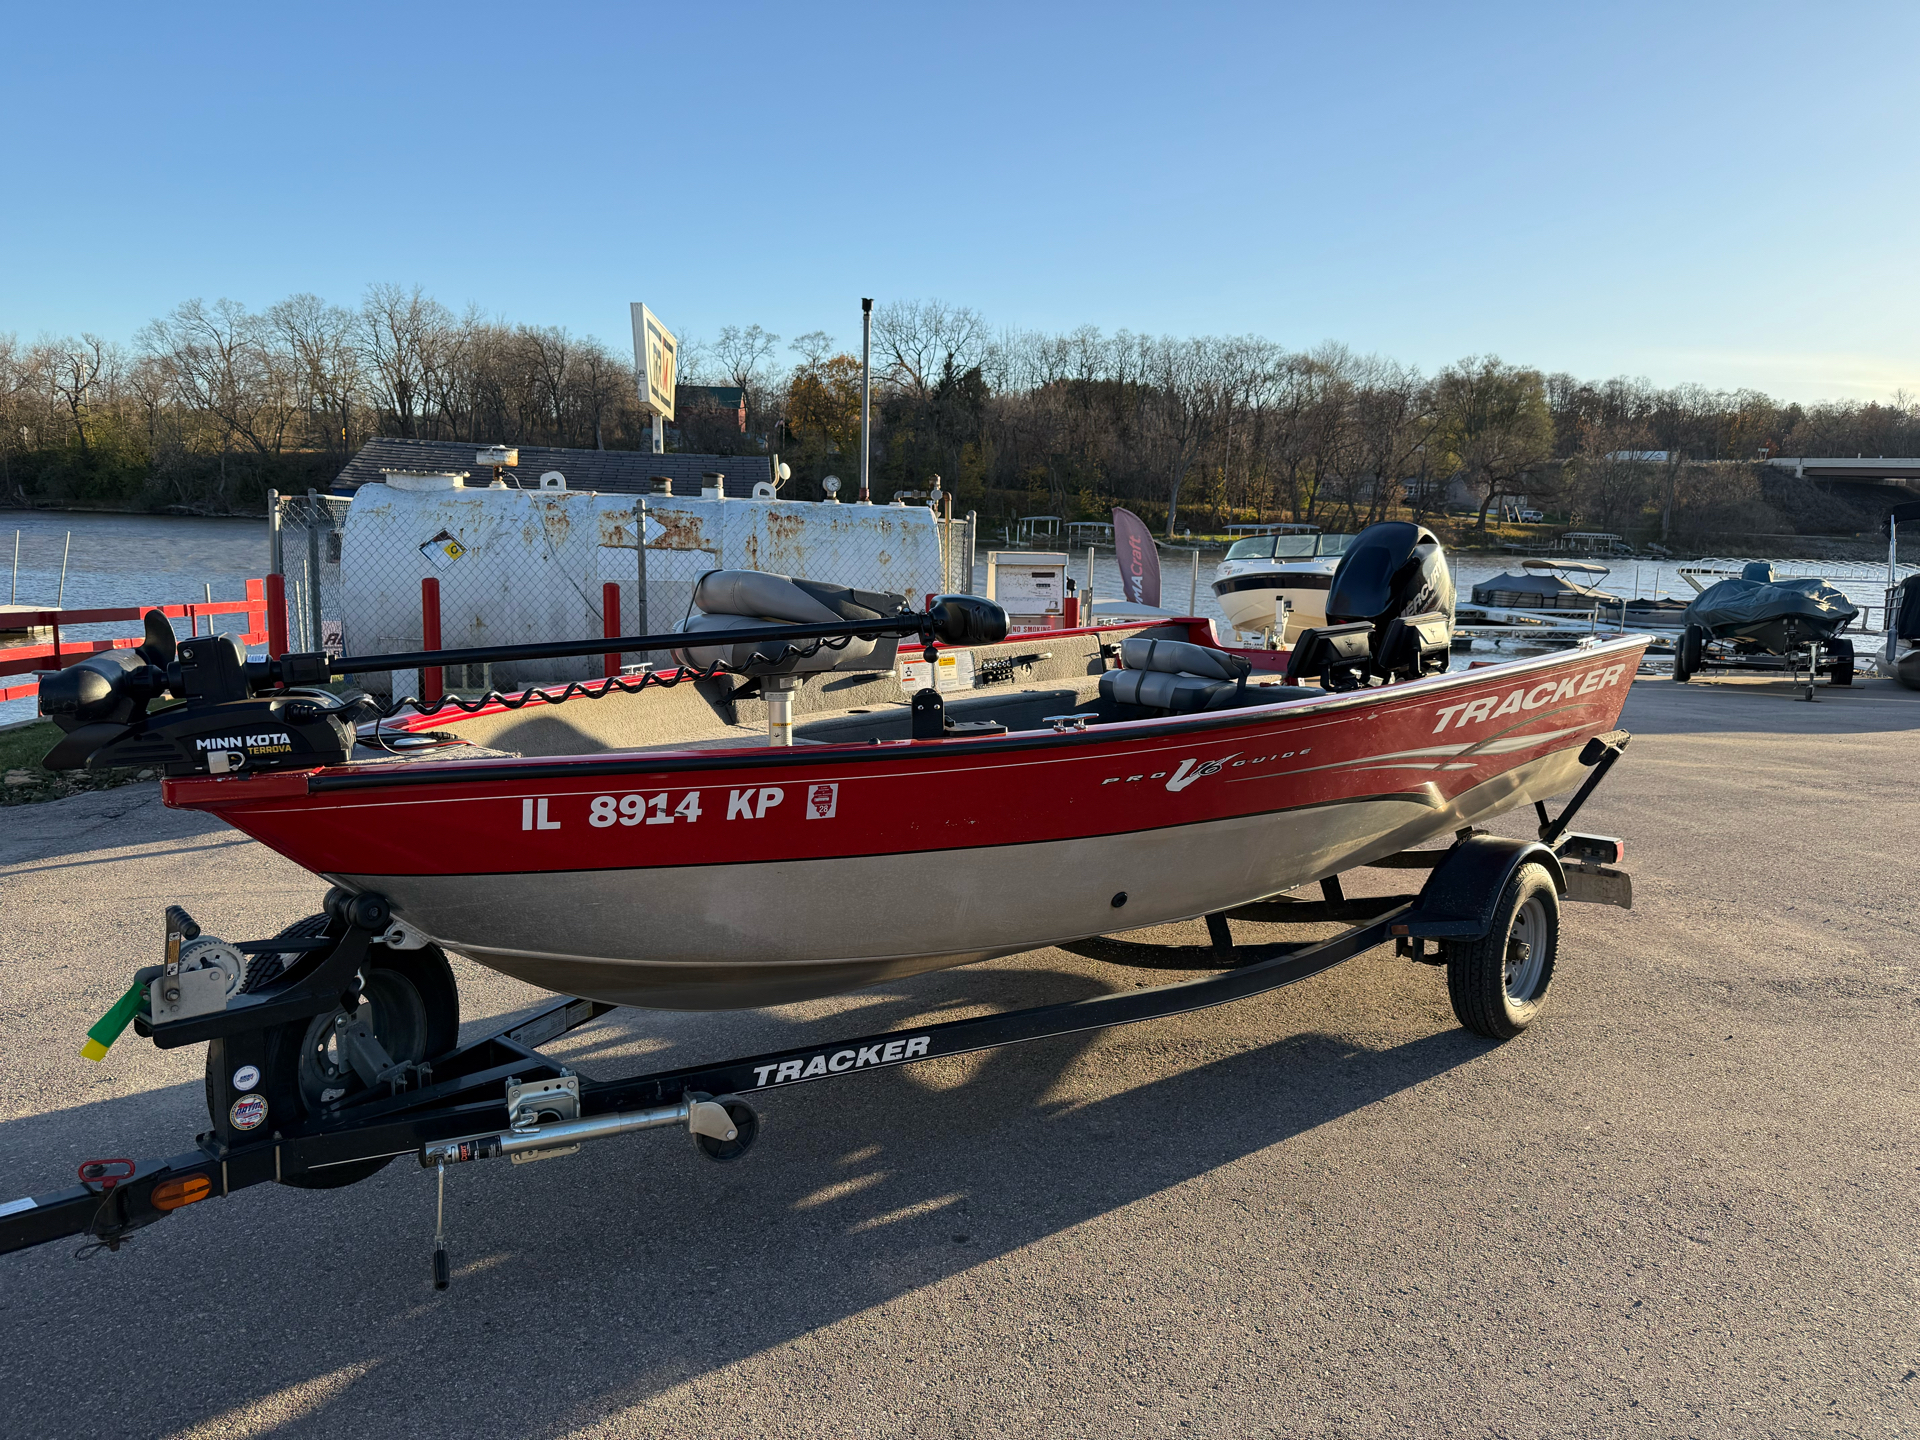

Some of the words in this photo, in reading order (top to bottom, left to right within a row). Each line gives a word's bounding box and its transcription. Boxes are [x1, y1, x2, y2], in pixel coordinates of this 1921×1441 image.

[1012, 625, 1021, 633] NO
[1023, 625, 1051, 633] SMOKING
[1432, 664, 1626, 734] TRACKER
[196, 736, 243, 750] MINN
[245, 733, 291, 747] KOTA
[247, 745, 292, 755] TERROVA
[1101, 771, 1167, 786] PRO
[1232, 748, 1312, 767] GUIDE
[522, 798, 561, 831] IL
[588, 791, 703, 828] 8914
[726, 787, 785, 820] KP
[819, 805, 829, 813] 28
[753, 1035, 931, 1087] TRACKER
